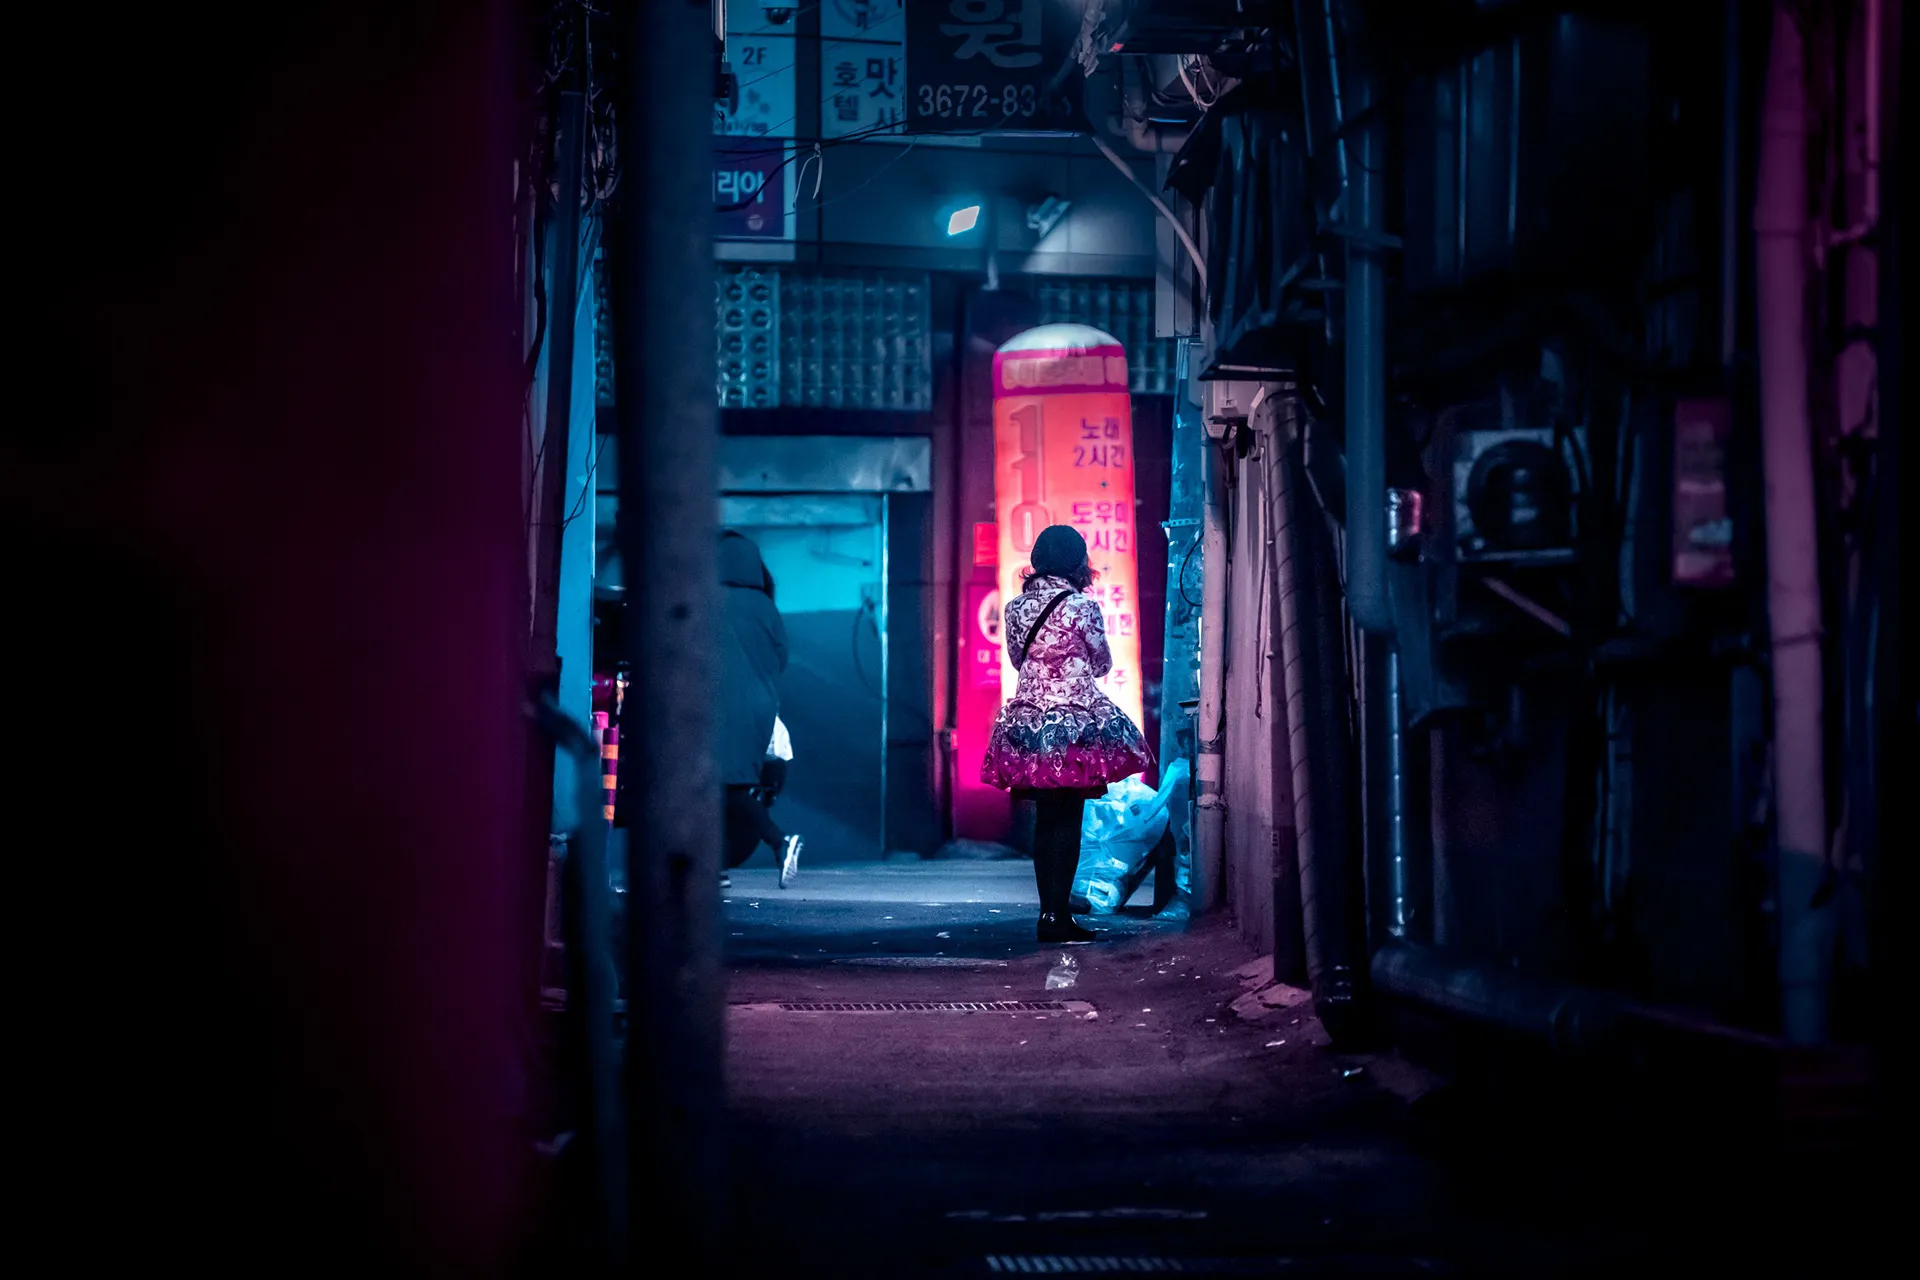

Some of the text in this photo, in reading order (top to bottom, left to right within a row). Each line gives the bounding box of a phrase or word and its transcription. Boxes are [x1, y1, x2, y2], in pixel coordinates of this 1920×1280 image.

[743, 46, 767, 65] 2F
[1081, 417, 1120, 440] 노래
[1073, 444, 1126, 469] 2시간
